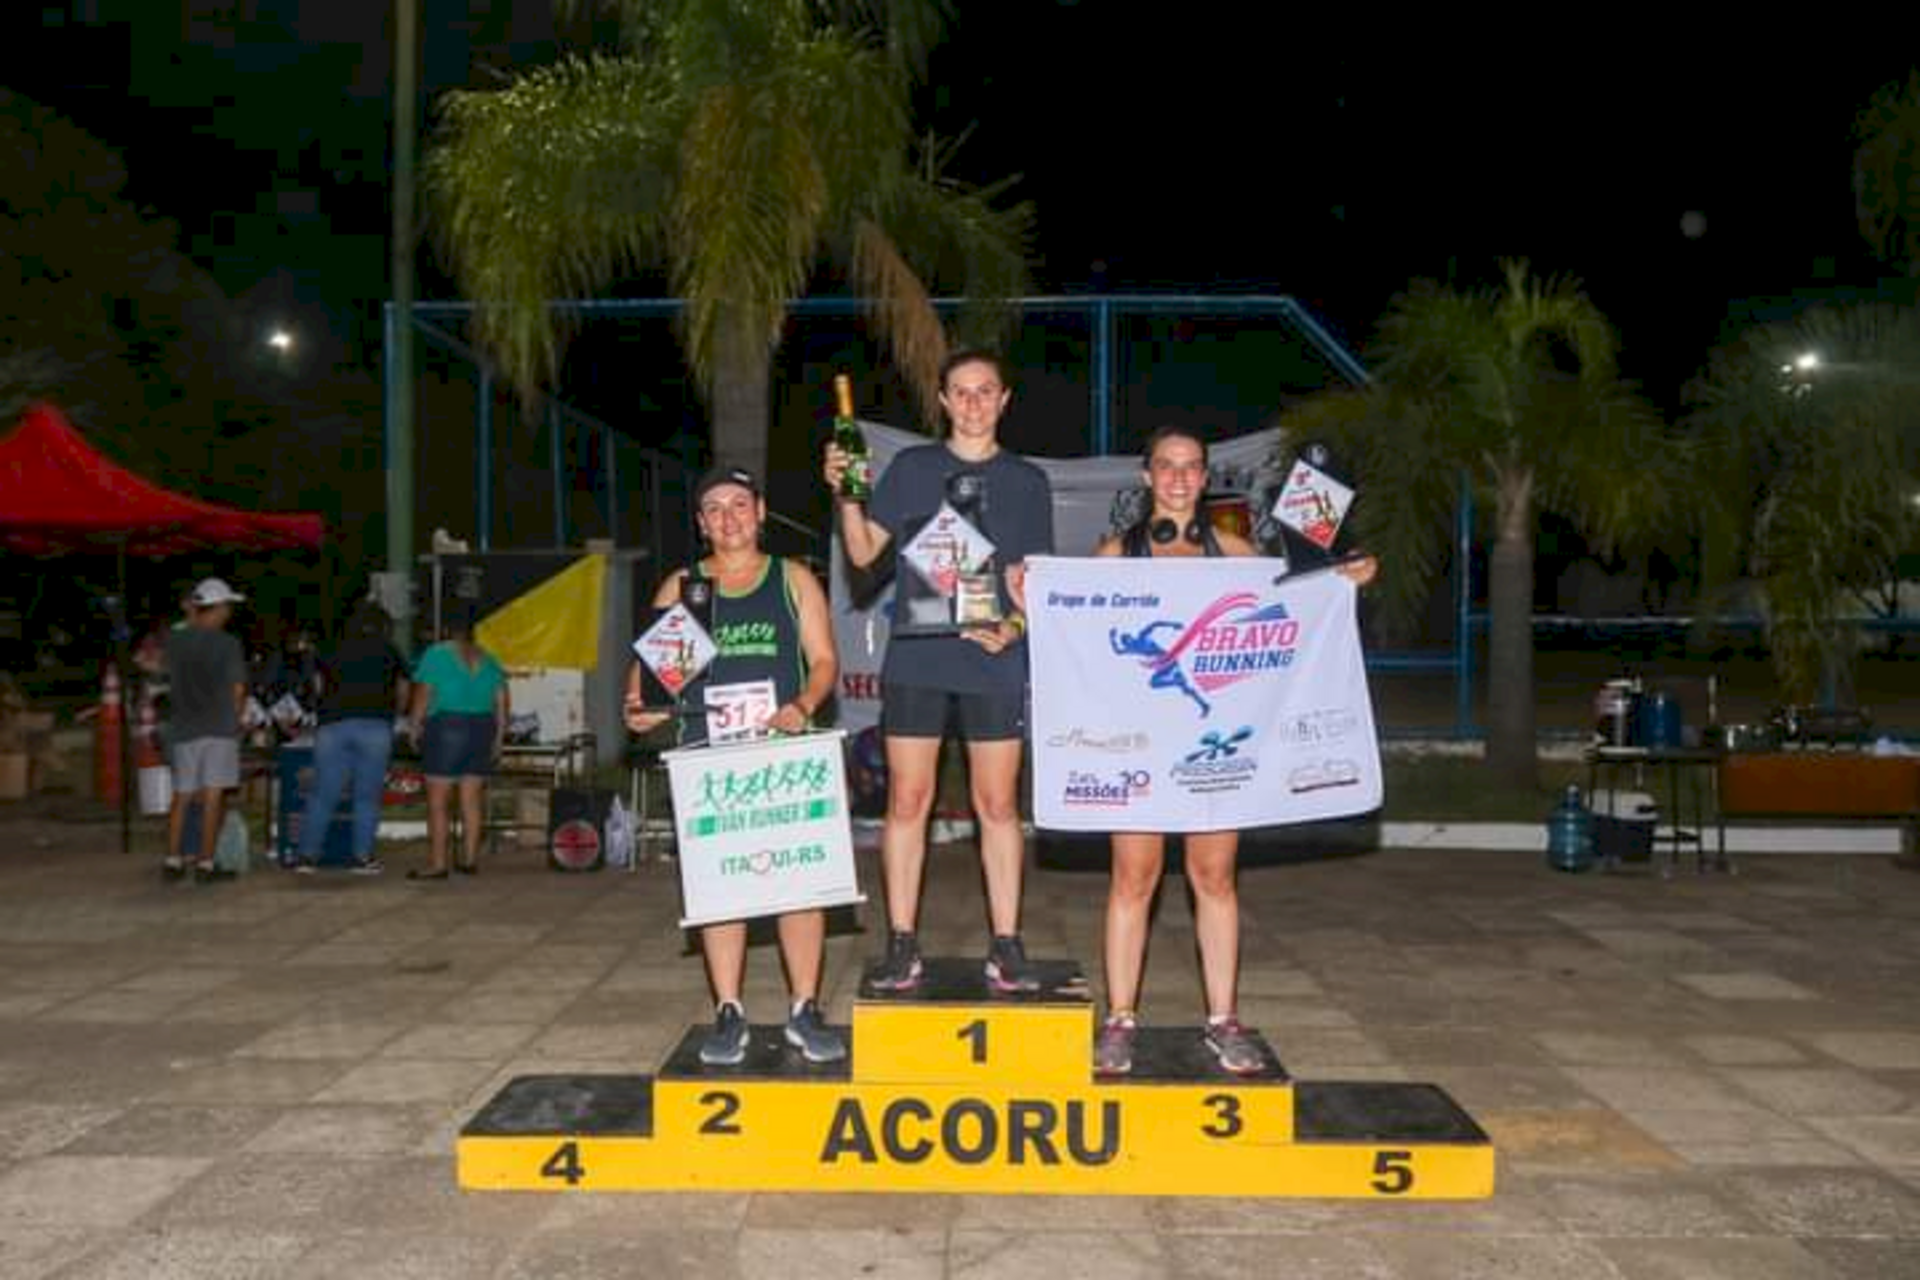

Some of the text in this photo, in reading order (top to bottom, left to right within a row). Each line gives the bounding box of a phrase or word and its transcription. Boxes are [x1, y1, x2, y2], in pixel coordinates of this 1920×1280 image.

[1195, 620, 1299, 652] BRAVO
[1194, 648, 1296, 673] RUNNING
[957, 1020, 988, 1063] 1
[700, 1092, 740, 1134] 2
[820, 1097, 1121, 1167] ACORU
[1202, 1094, 1242, 1138] 3
[541, 1141, 585, 1185] 4
[1373, 1150, 1414, 1195] 5
